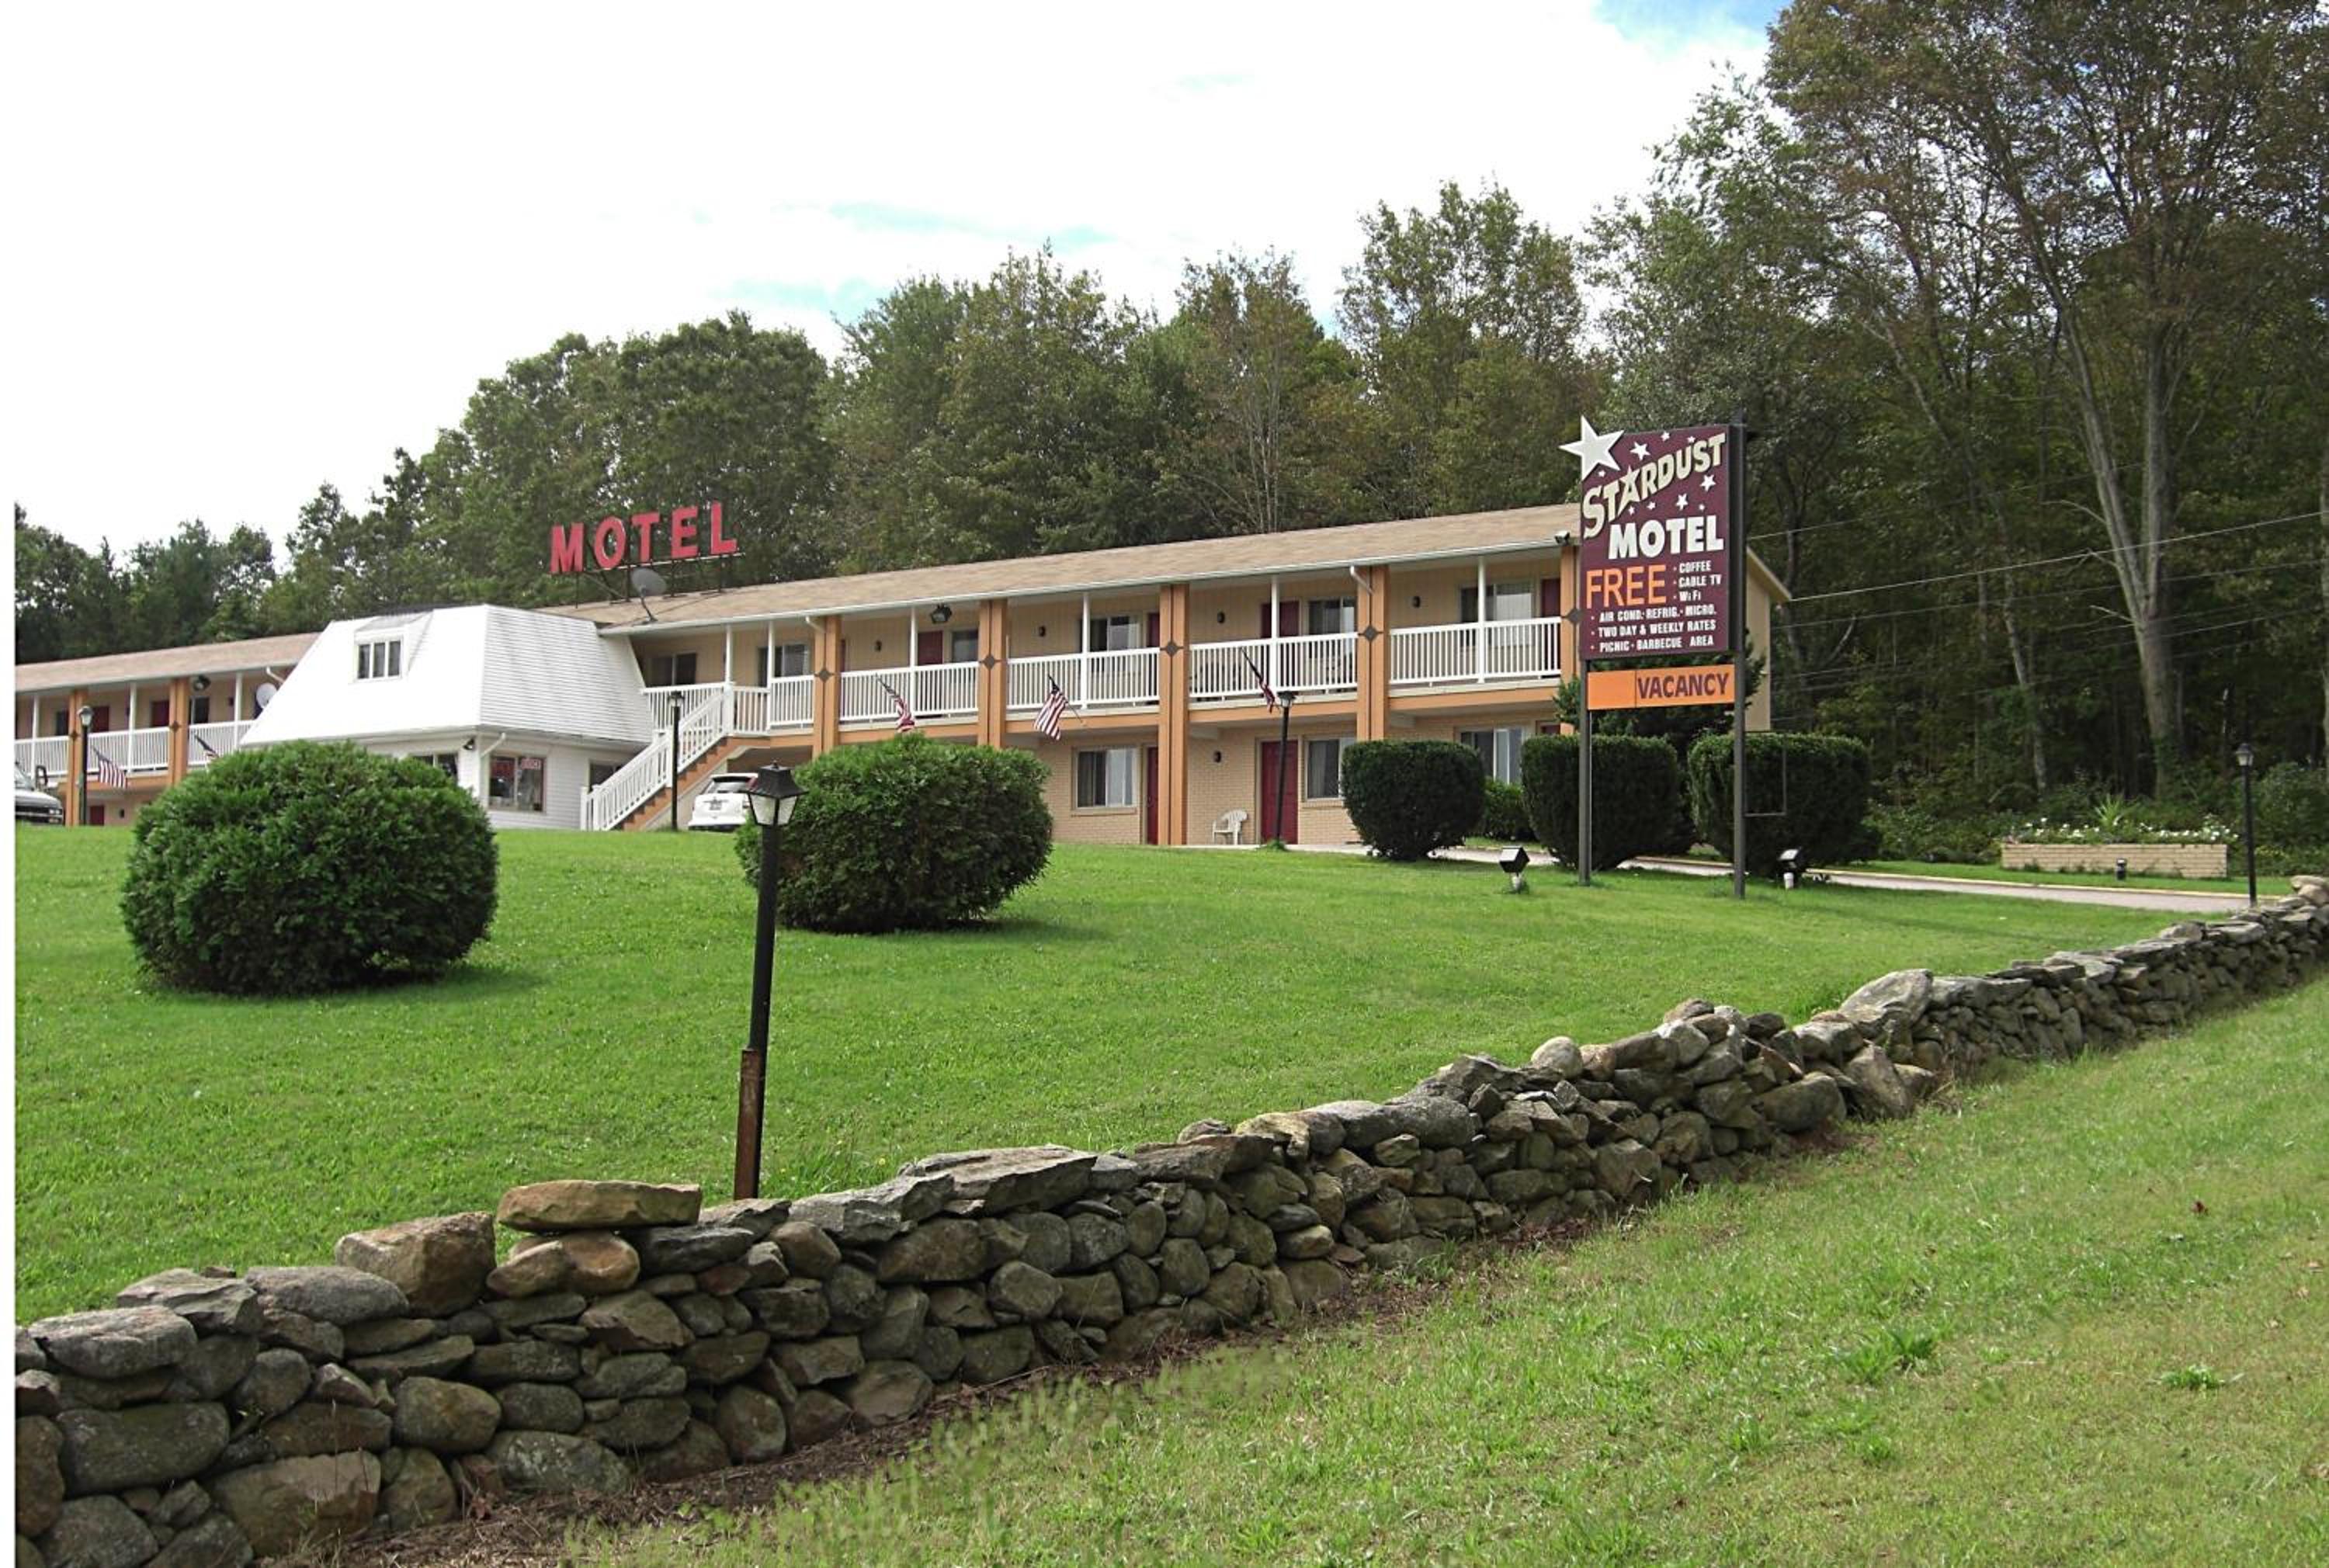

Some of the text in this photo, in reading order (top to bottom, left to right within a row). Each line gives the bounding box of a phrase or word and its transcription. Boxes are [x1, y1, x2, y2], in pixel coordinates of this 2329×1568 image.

[1583, 432, 1726, 539] STARDUST
[550, 499, 737, 573] MOTEL
[1609, 515, 1724, 559] MOTEL
[1679, 560, 1712, 573] COFFEE
[1586, 564, 1666, 609] FREE
[1678, 574, 1722, 588] CABLE TV
[1598, 619, 1716, 637] TWO DAY & WEEKLY RATES
[1599, 611, 1614, 623] AIR
[1599, 635, 1714, 653] PICNIC BARBECUE AREA
[1638, 673, 1729, 699] VACANCY
